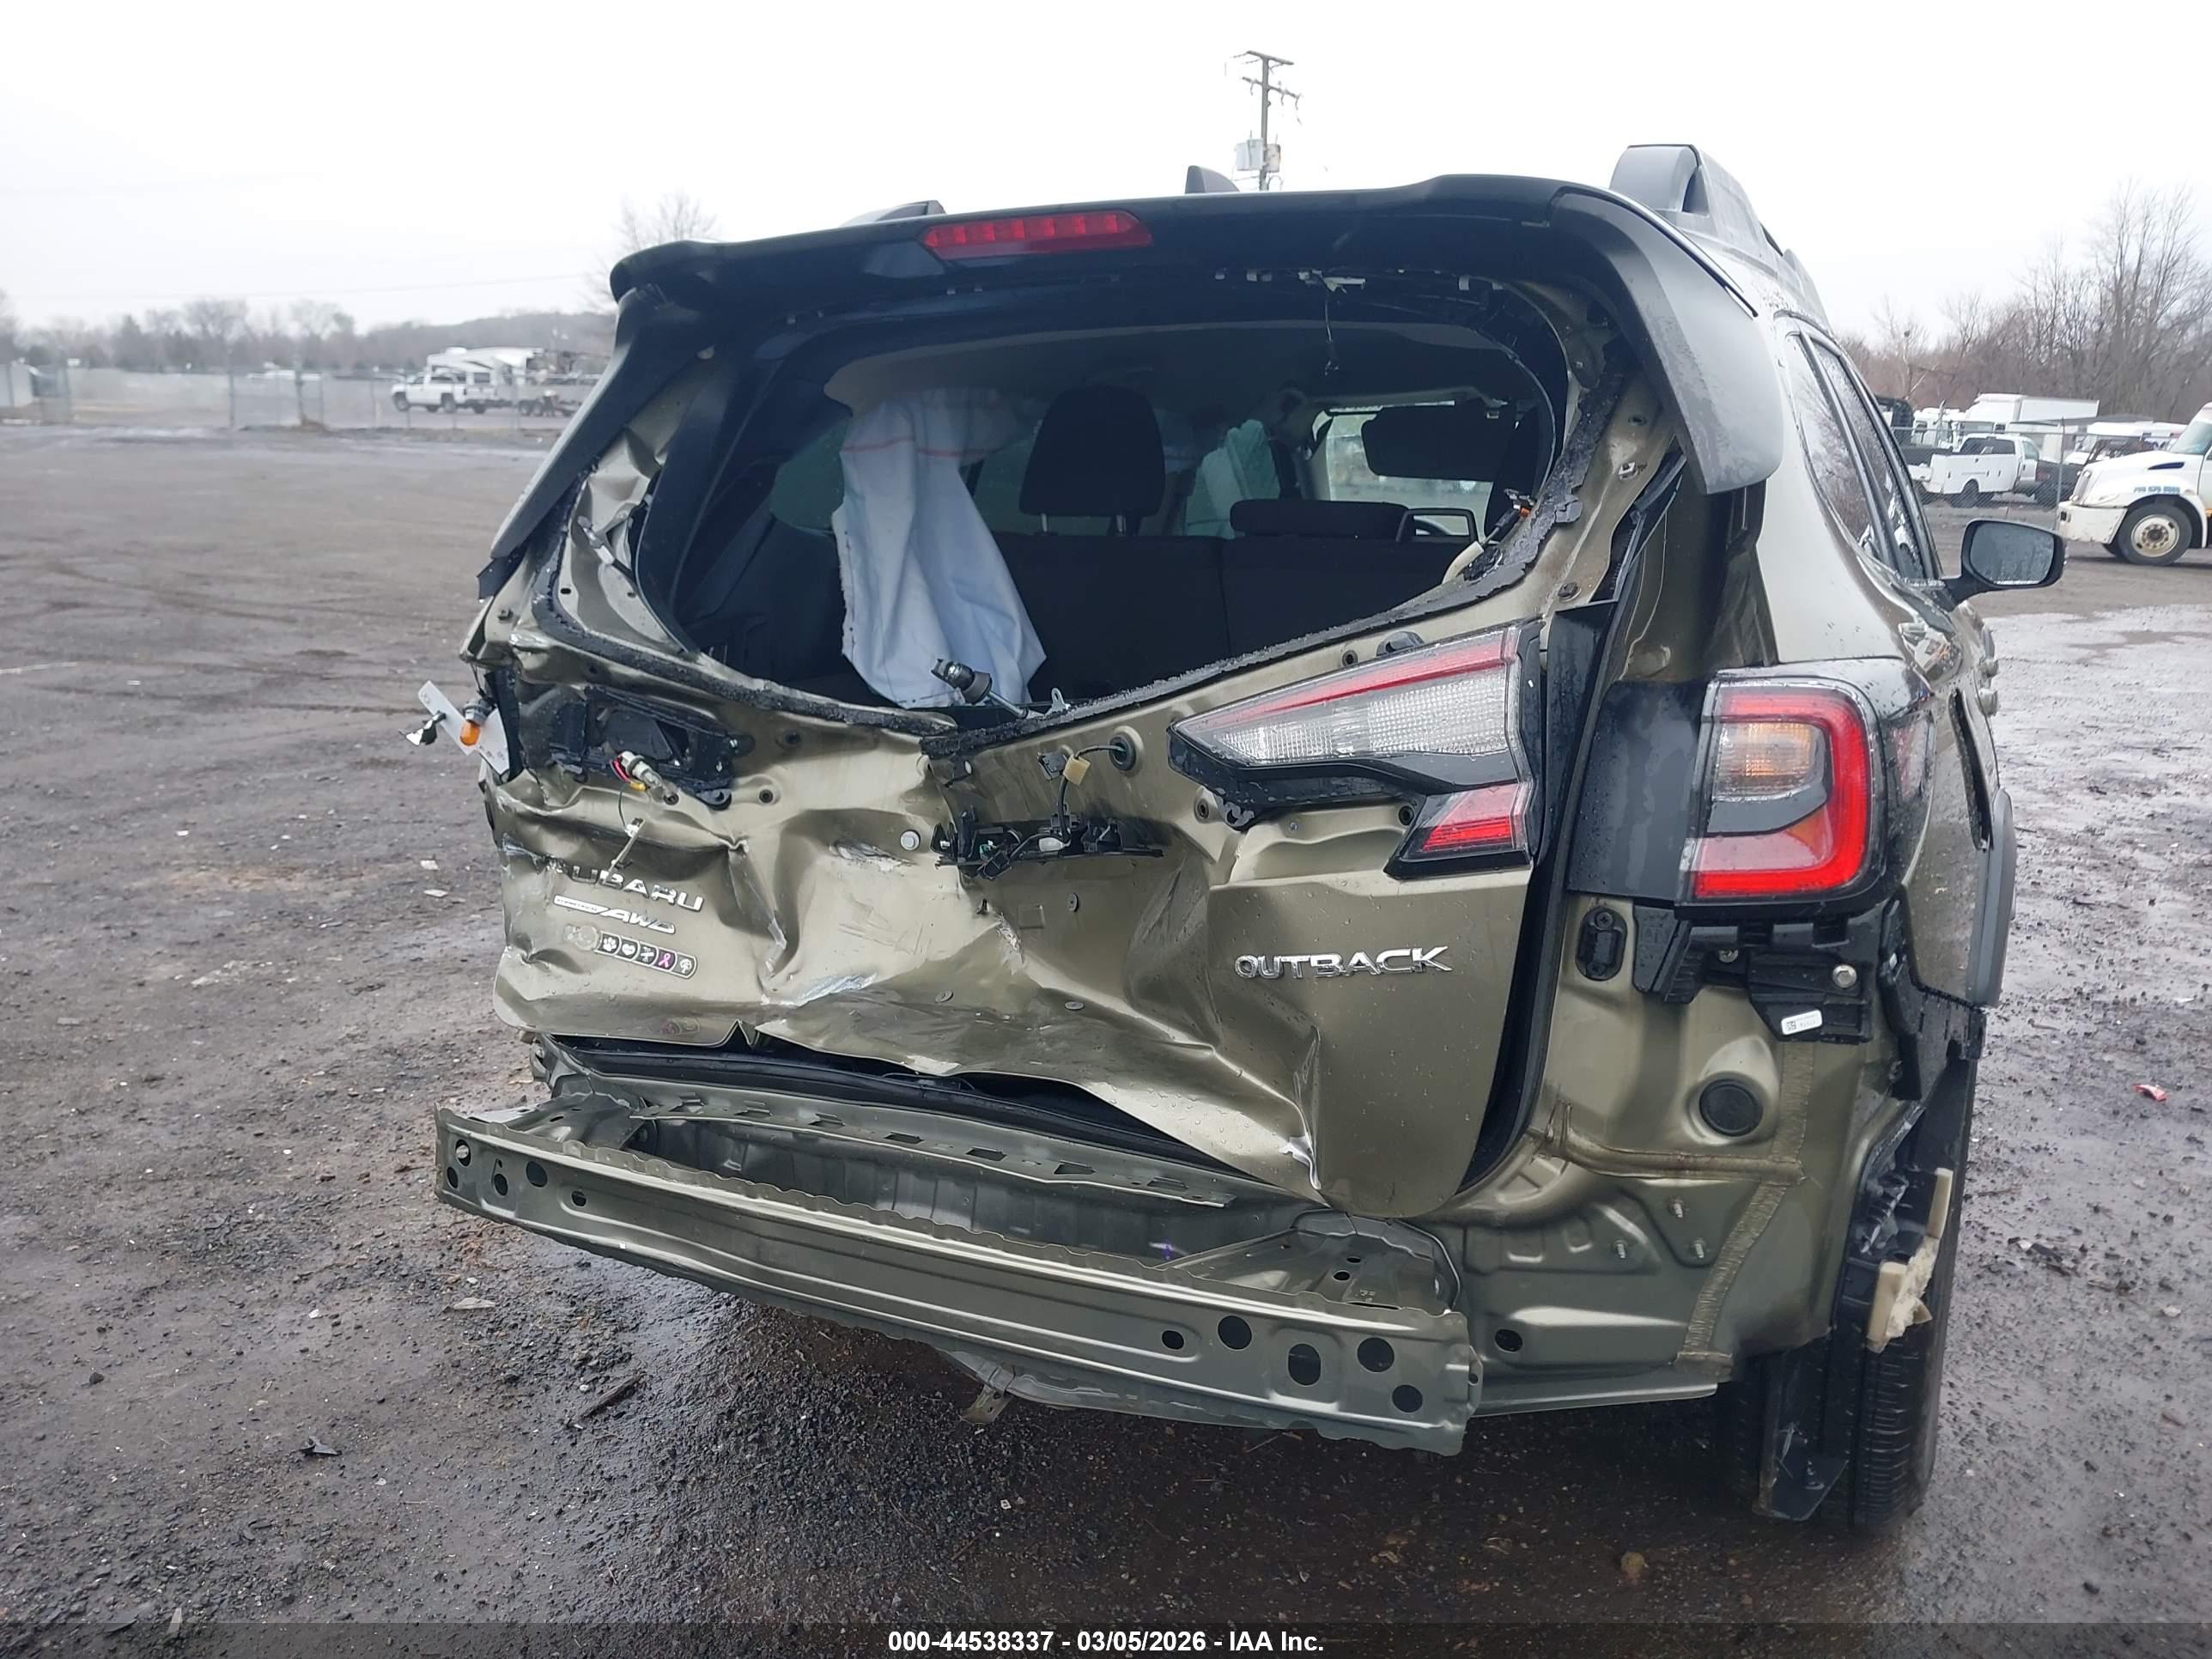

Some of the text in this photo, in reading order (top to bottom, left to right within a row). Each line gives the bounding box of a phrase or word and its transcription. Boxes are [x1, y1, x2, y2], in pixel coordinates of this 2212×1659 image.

[560, 861, 703, 912] UBARU
[600, 908, 675, 934] AWD
[1234, 945, 1453, 980] OUTBACK
